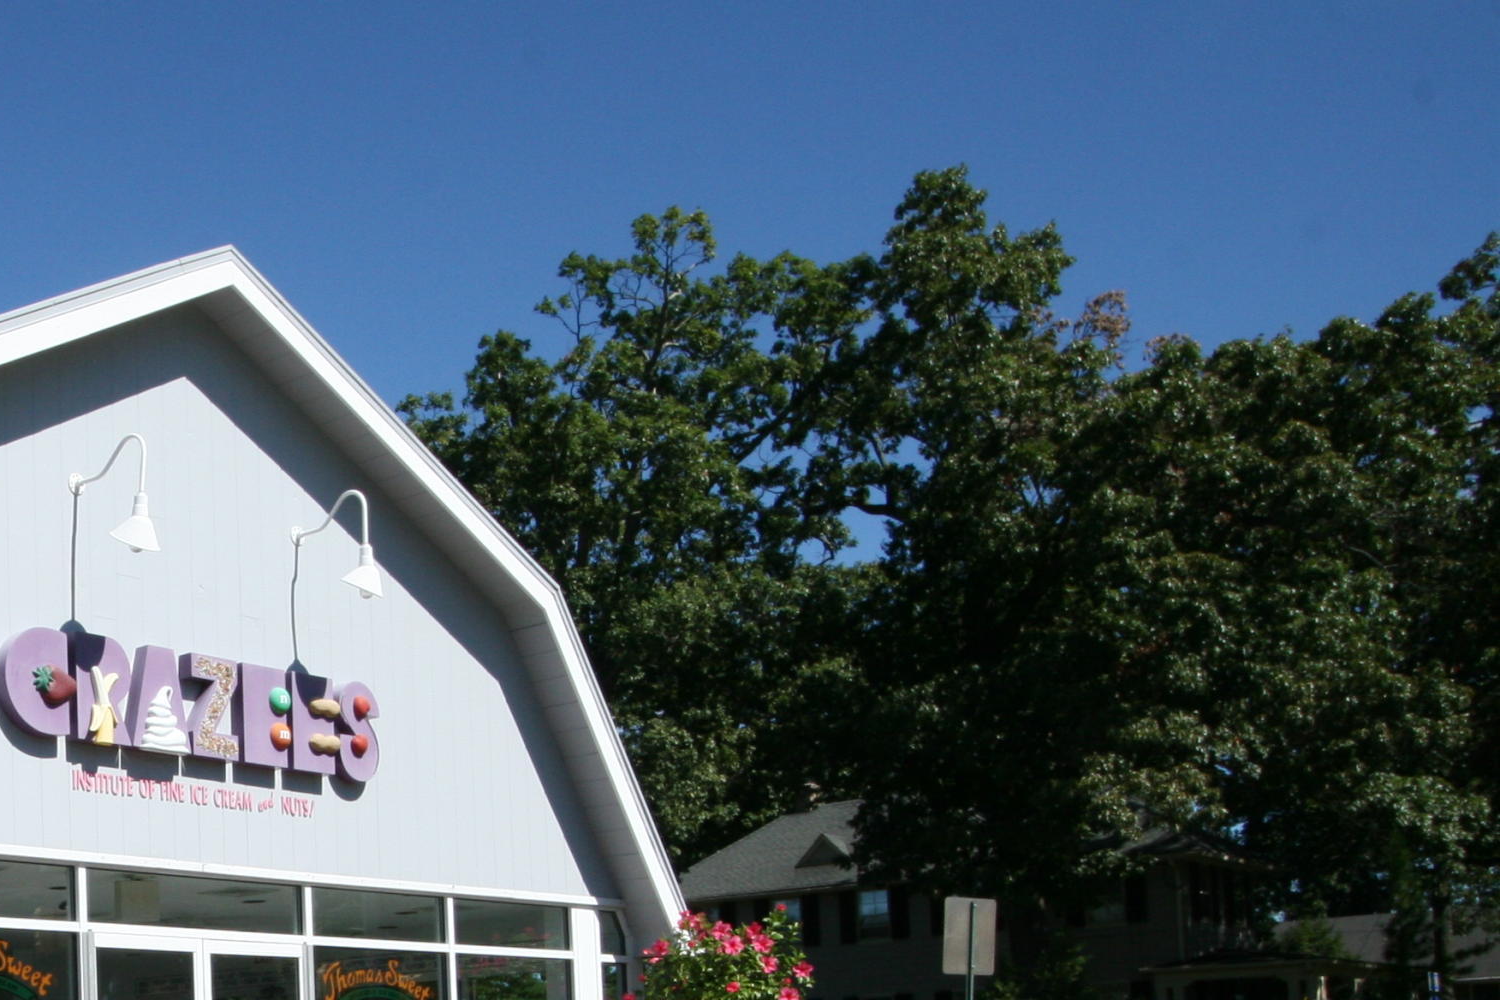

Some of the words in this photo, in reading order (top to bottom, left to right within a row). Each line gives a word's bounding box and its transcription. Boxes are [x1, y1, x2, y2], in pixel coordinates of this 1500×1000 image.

[72, 769, 133, 797] INSTITUTE
[140, 778, 156, 799] OF
[160, 780, 185, 803] FINE
[189, 784, 208, 806] ICE
[213, 788, 253, 812] CREAM
[257, 791, 274, 813] and
